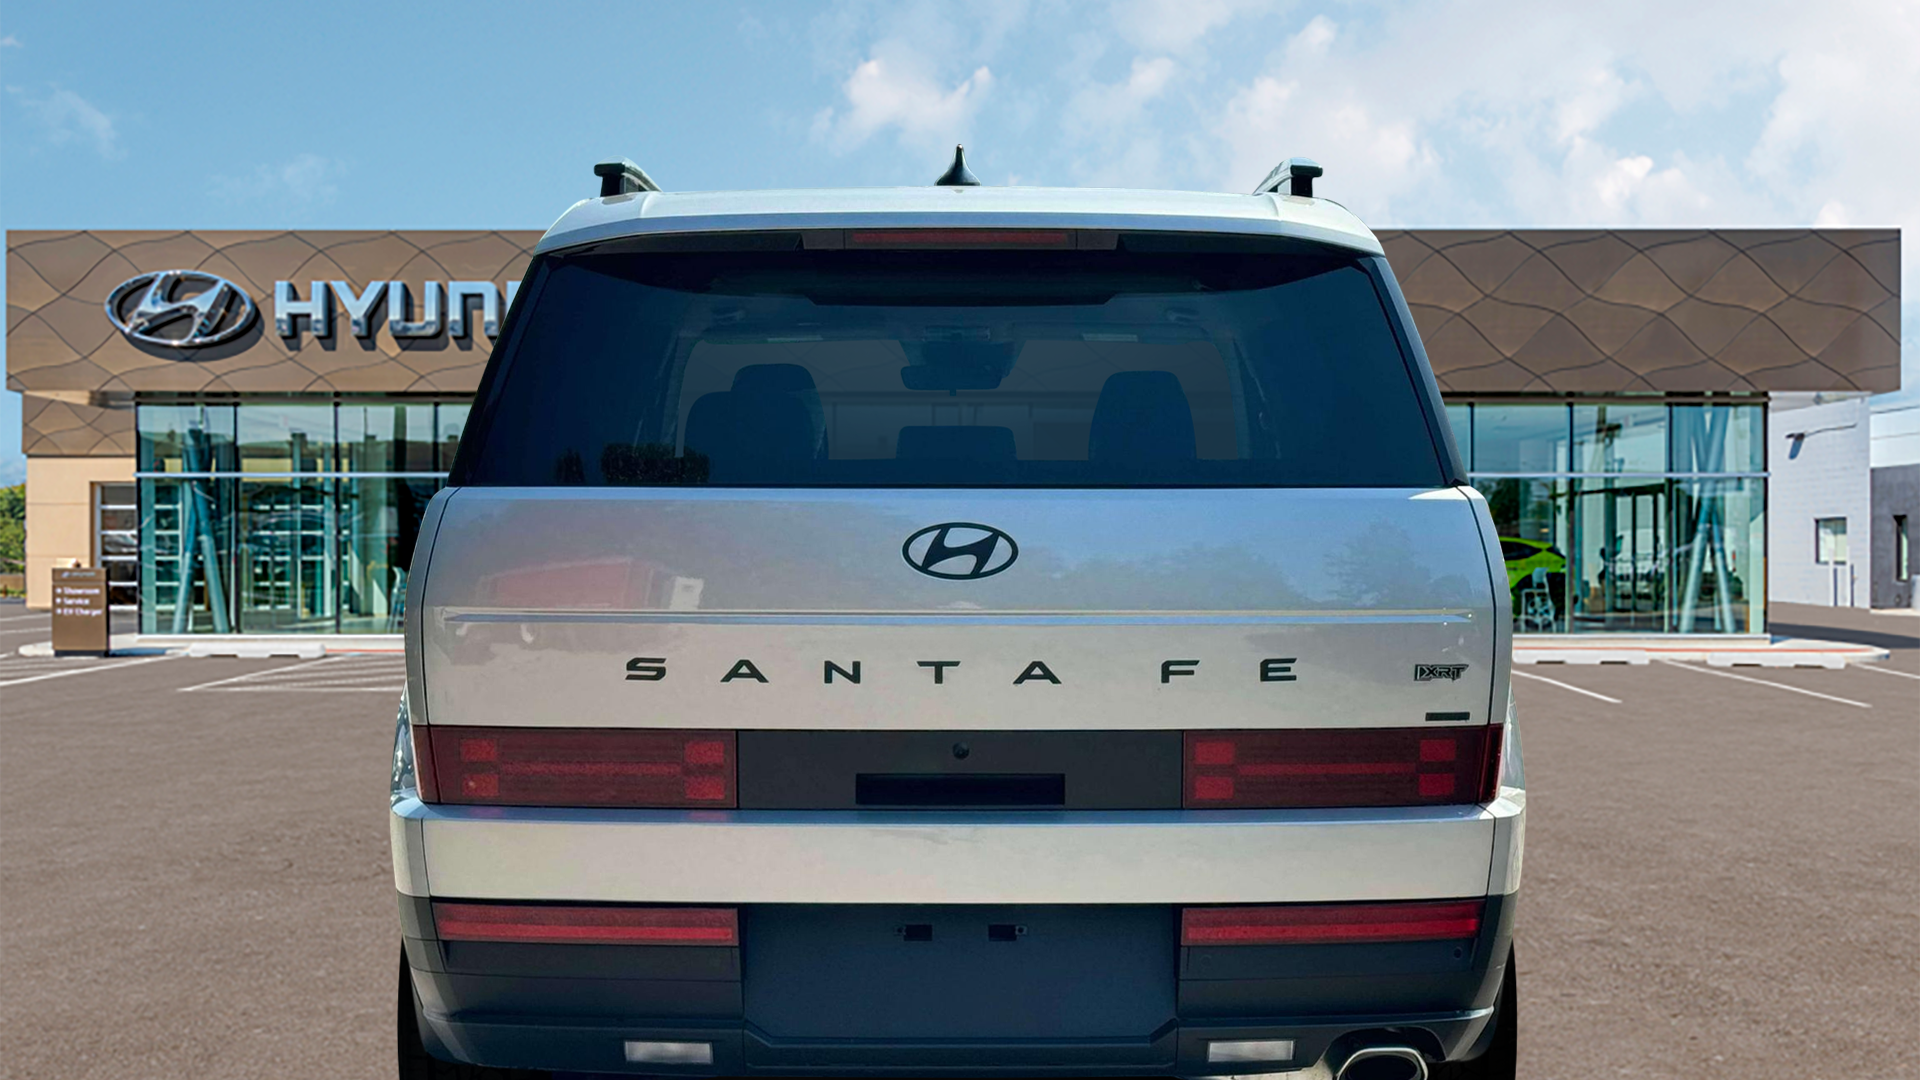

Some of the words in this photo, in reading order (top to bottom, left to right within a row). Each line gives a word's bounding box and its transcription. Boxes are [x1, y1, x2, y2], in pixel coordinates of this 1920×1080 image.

[275, 280, 521, 337] HYUN
[625, 657, 1062, 684] SANTA
[1160, 657, 1298, 684] FE
[1420, 664, 1469, 681] XRT
